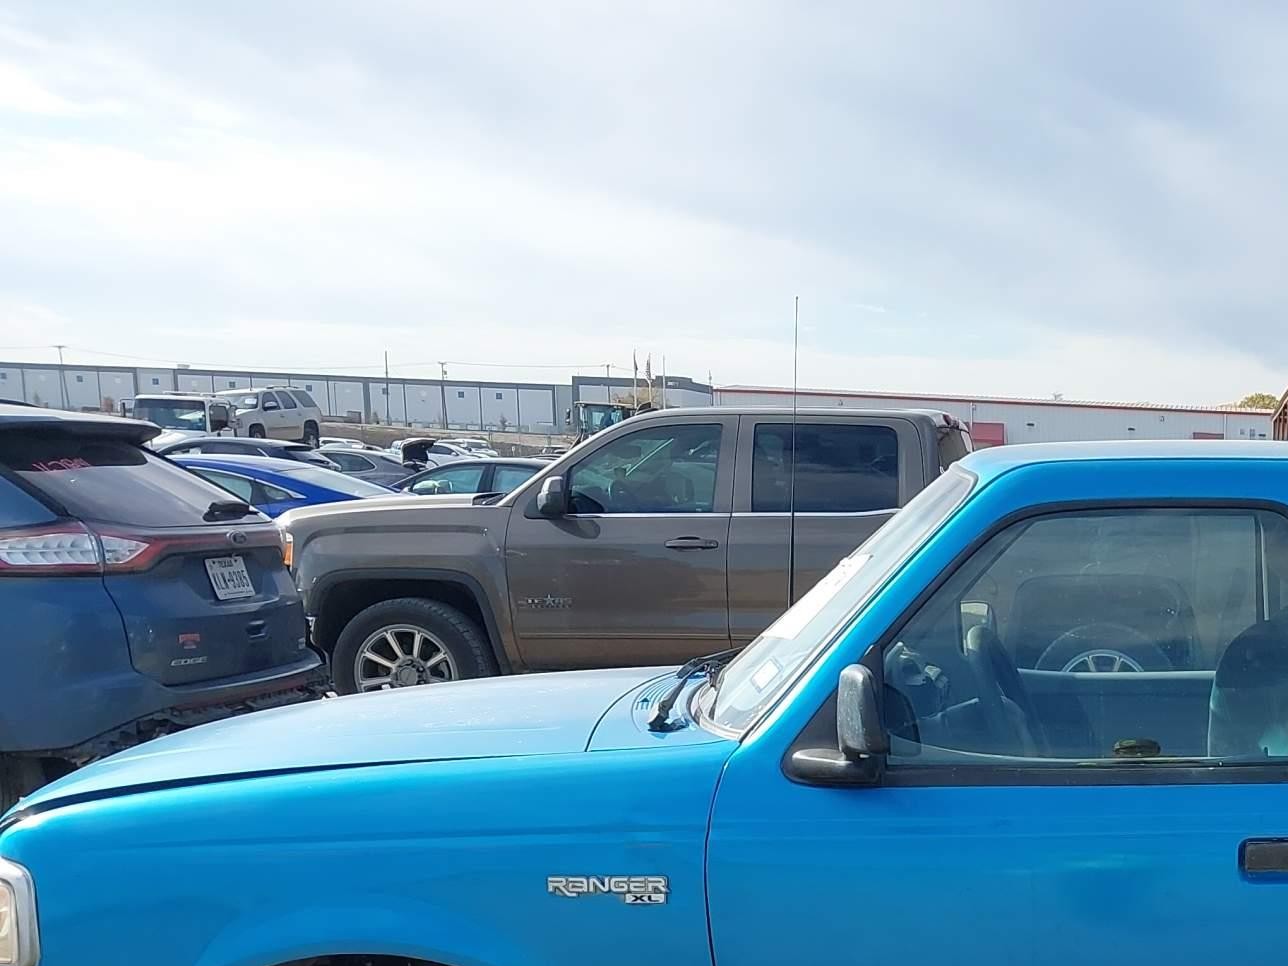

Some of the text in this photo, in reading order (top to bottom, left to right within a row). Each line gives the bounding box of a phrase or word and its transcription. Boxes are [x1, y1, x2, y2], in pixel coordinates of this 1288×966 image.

[170, 656, 208, 667] EDGE
[547, 876, 669, 897] RANGER
[627, 893, 664, 904] XL
